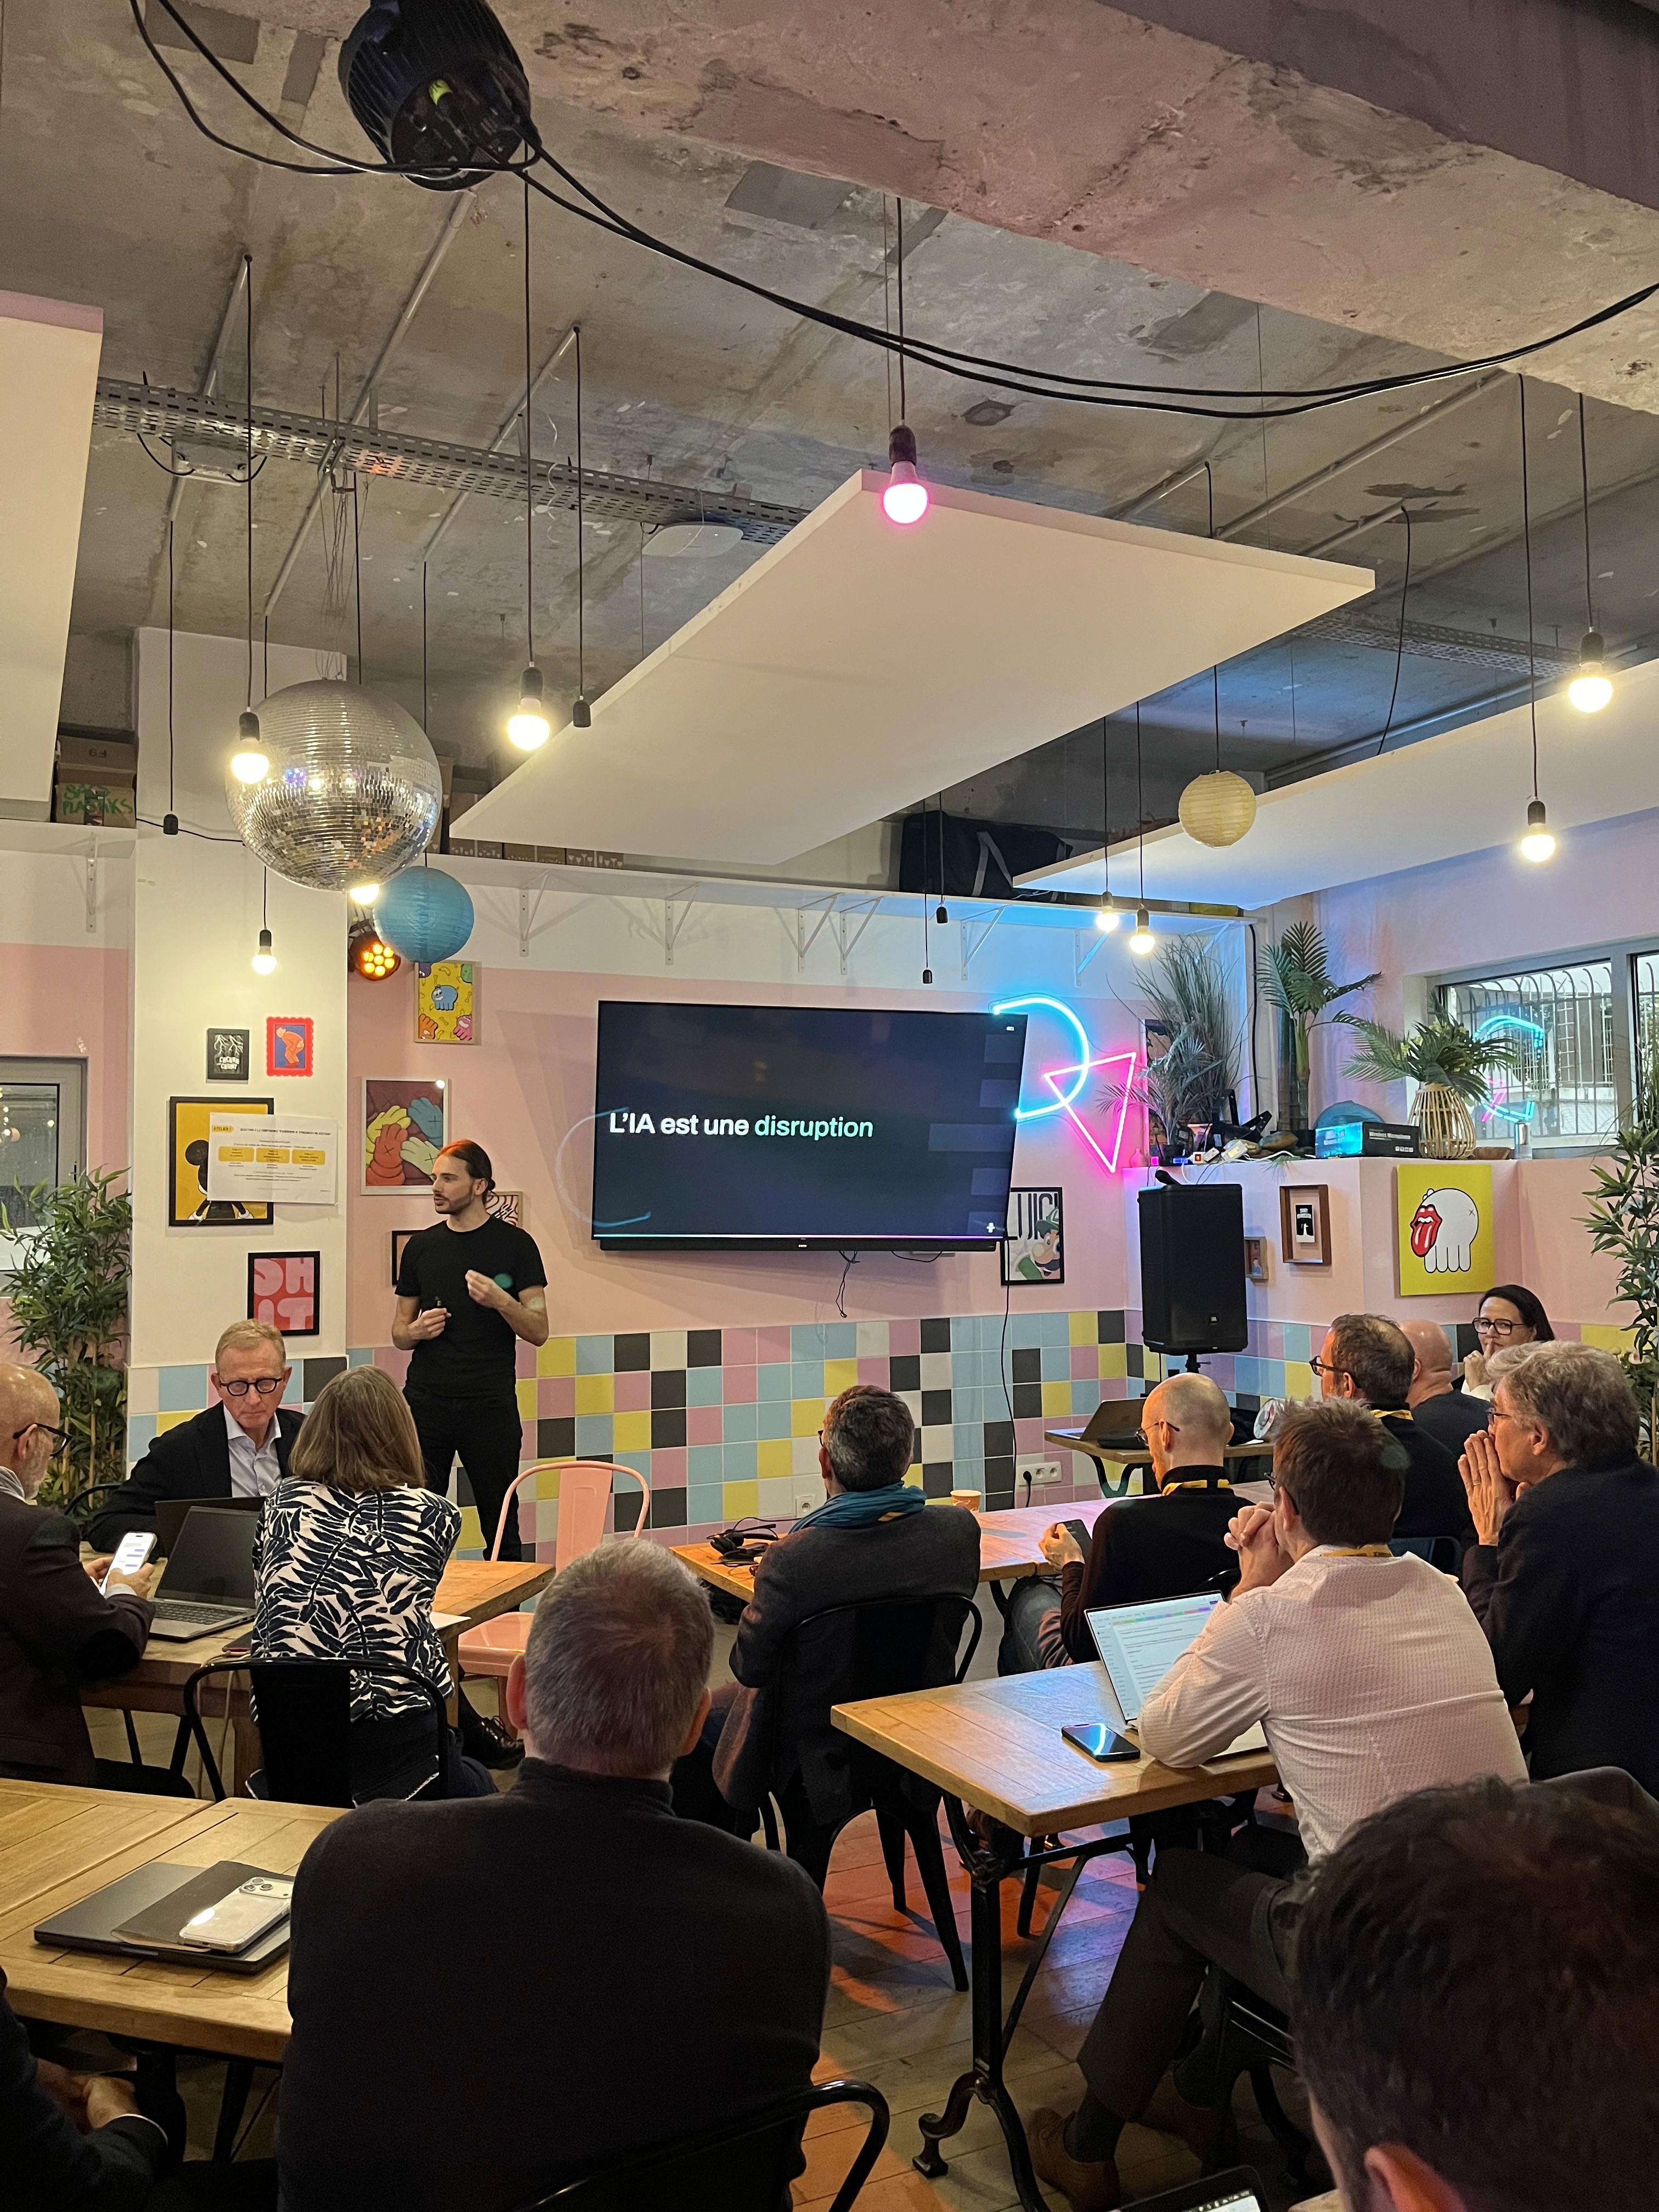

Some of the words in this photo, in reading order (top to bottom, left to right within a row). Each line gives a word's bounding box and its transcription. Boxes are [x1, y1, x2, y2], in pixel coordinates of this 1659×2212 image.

[610, 1113, 656, 1134] L’IA
[660, 1114, 698, 1136] est
[703, 1118, 749, 1136] une
[754, 1115, 873, 1141] disruption
[1008, 1193, 1058, 1240] UIG
